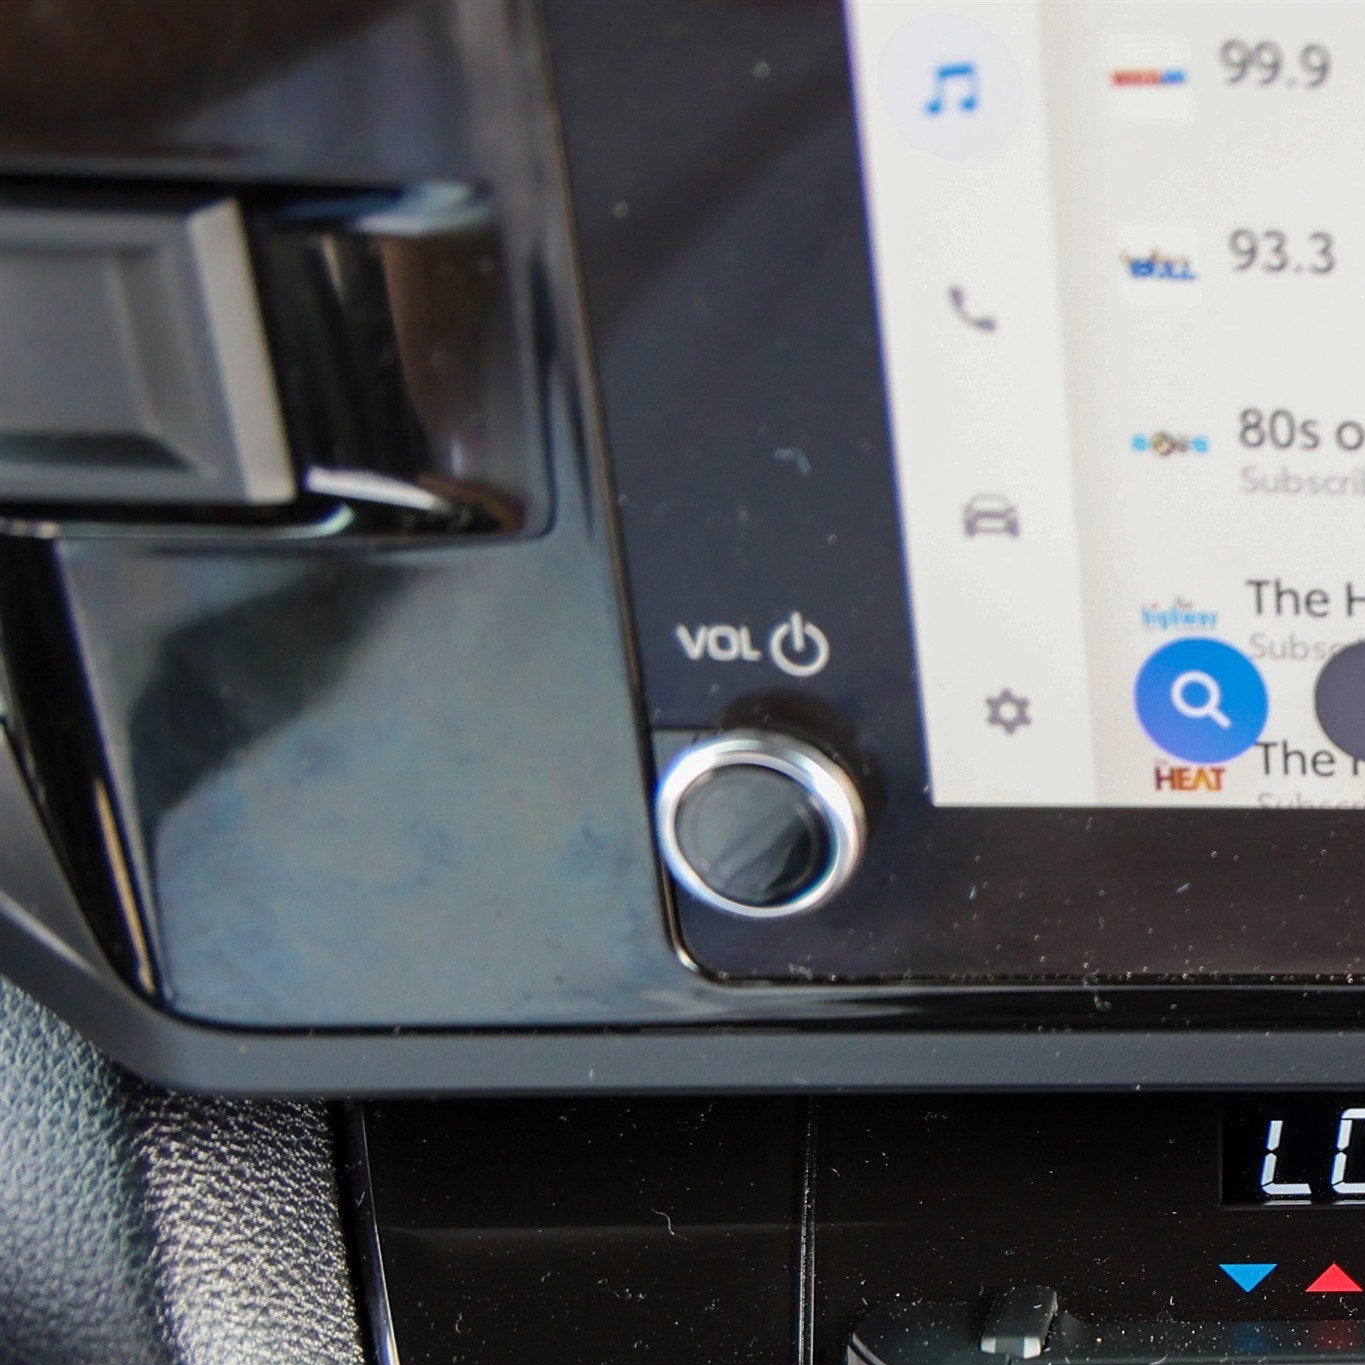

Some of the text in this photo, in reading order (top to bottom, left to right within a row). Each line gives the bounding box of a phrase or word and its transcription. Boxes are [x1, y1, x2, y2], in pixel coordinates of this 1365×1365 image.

[1218, 39, 1332, 88] 99.9
[1228, 228, 1336, 276] 93.3
[1239, 408, 1320, 451] 80s
[1245, 578, 1330, 618] The
[674, 623, 763, 661] VOL
[1154, 766, 1226, 791] HEAT
[1255, 740, 1335, 777] The
